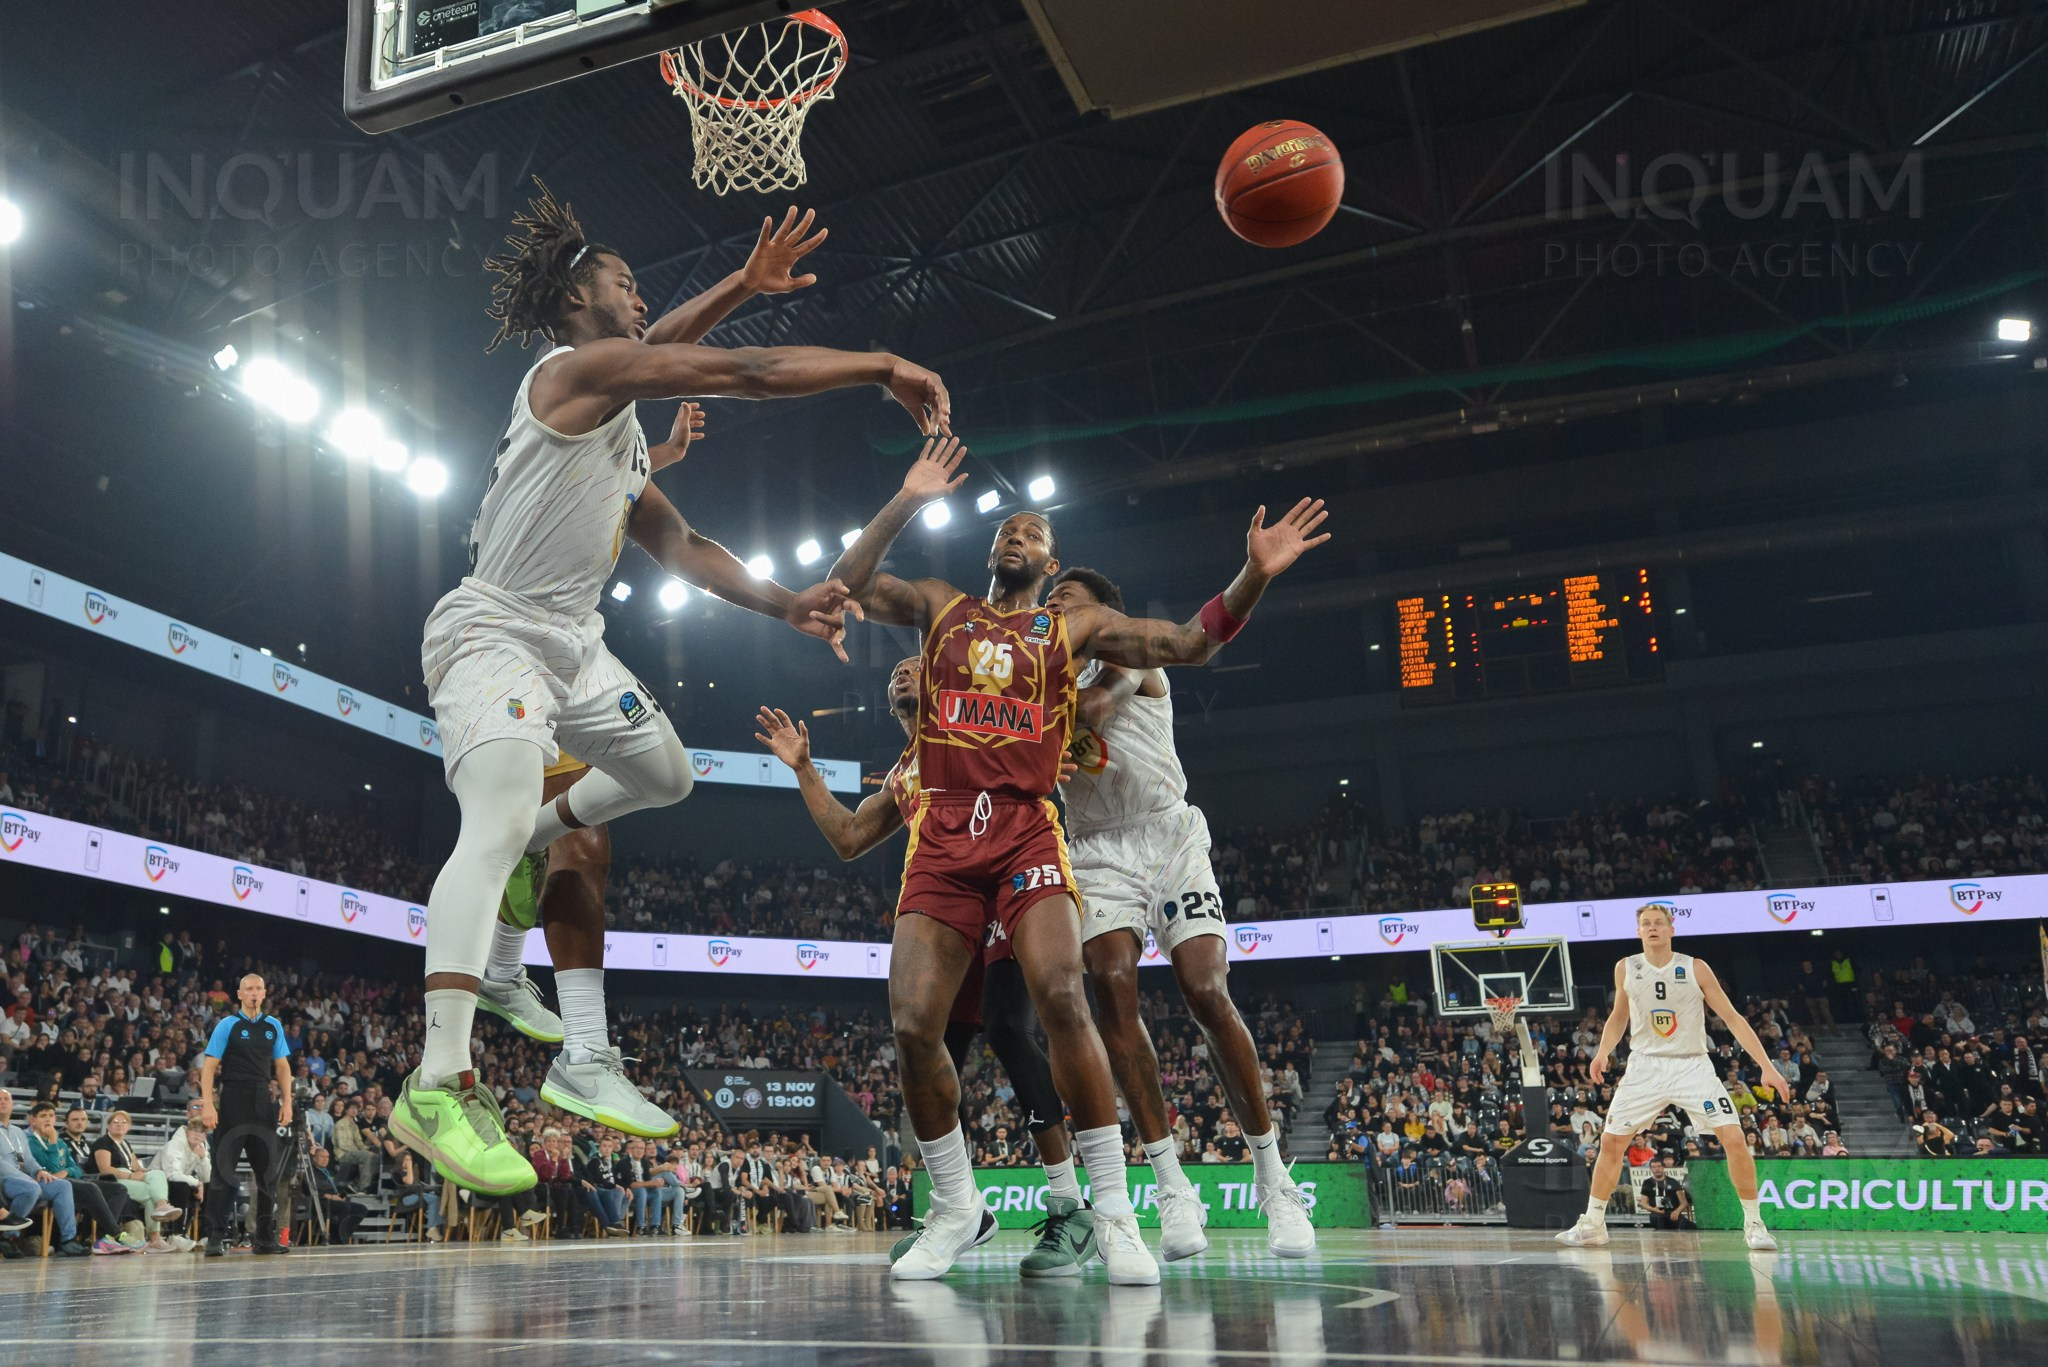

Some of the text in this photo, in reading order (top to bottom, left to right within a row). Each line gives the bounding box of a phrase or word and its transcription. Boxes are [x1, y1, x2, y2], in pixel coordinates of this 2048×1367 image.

[432, 2, 477, 21] oneteam
[975, 640, 1013, 679] 25
[945, 696, 1035, 734] UMANA
[1071, 734, 1094, 758] BT
[817, 767, 837, 778] TPay
[1026, 865, 1061, 891] 25
[1181, 891, 1222, 922] 23
[1671, 906, 1693, 918] Pay
[1655, 981, 1666, 1000] 9
[1656, 1016, 1671, 1025] BT
[766, 1082, 815, 1092] 13 NOV
[767, 1095, 815, 1107] 19:00
[1718, 1097, 1733, 1114] 9
[1757, 1179, 2048, 1211] AGRICULTUR
